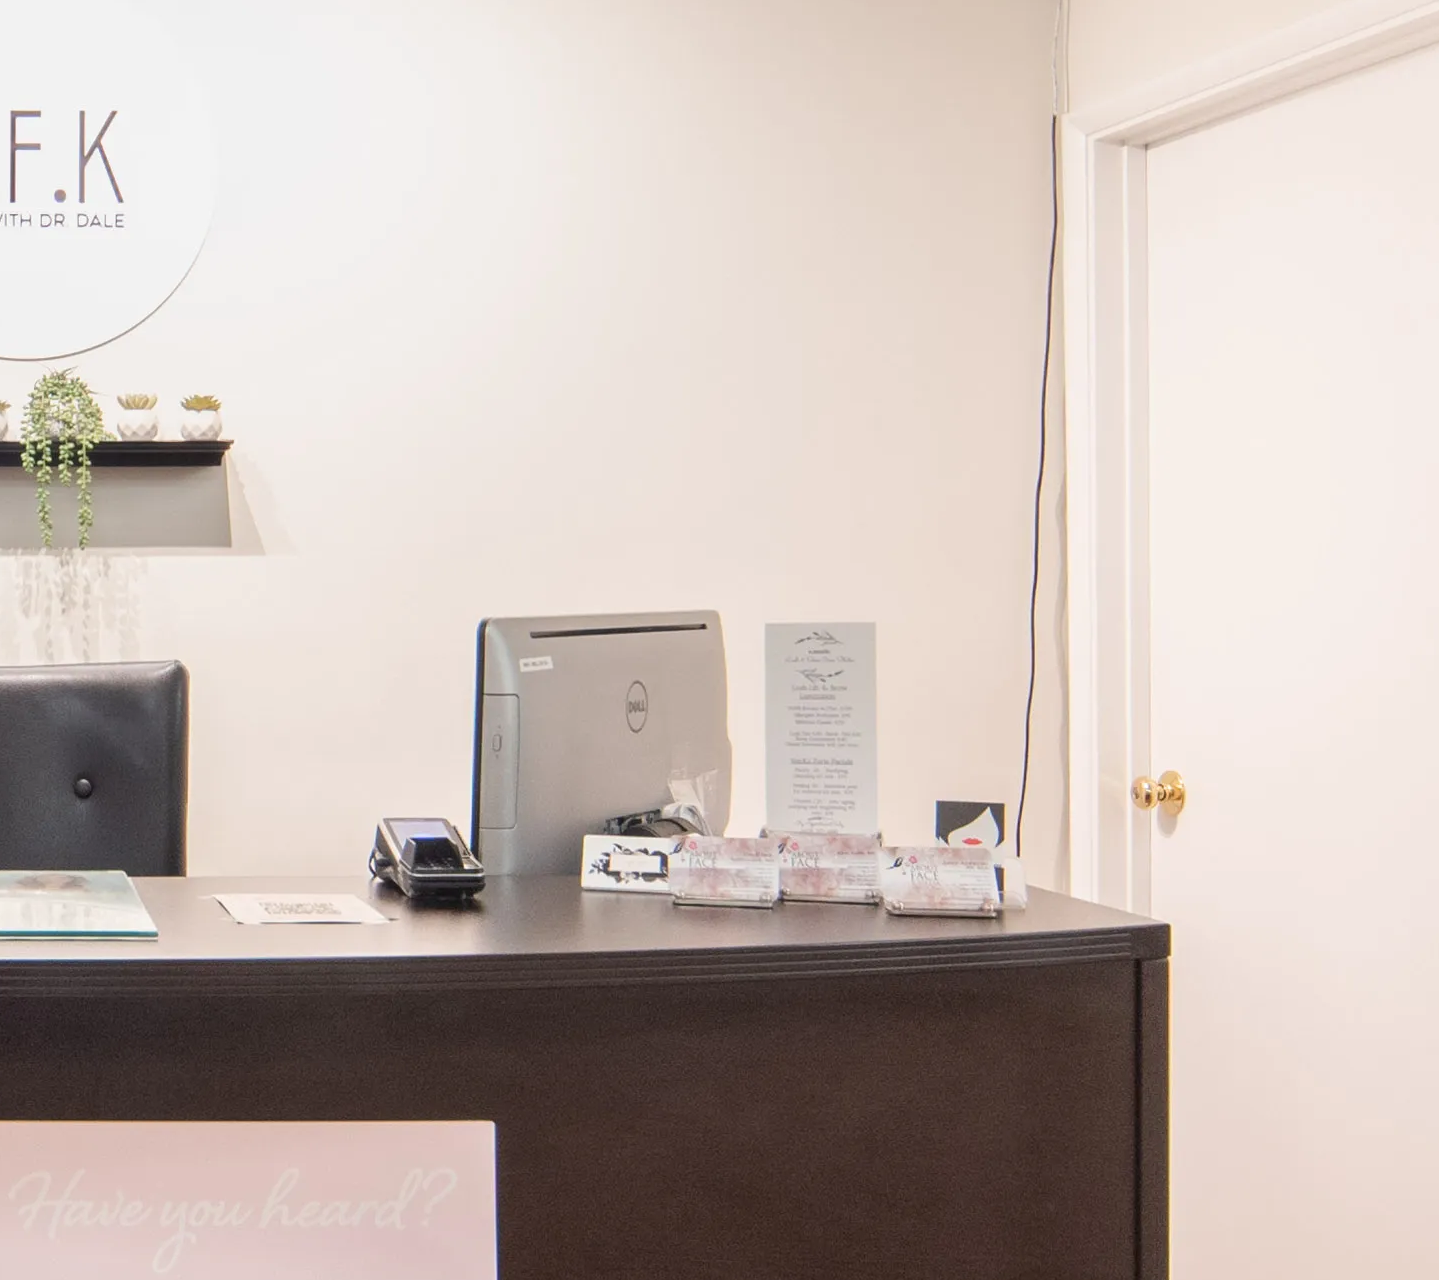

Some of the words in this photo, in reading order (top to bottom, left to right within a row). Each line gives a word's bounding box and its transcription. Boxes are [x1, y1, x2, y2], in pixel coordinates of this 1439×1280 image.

[76, 213, 125, 228] DALE
[688, 857, 718, 868] FACE
[790, 857, 820, 868] FACE
[910, 870, 939, 881] FACE
[8, 1169, 151, 1239] Have
[152, 1198, 252, 1273] you
[258, 1168, 458, 1230] heard?
